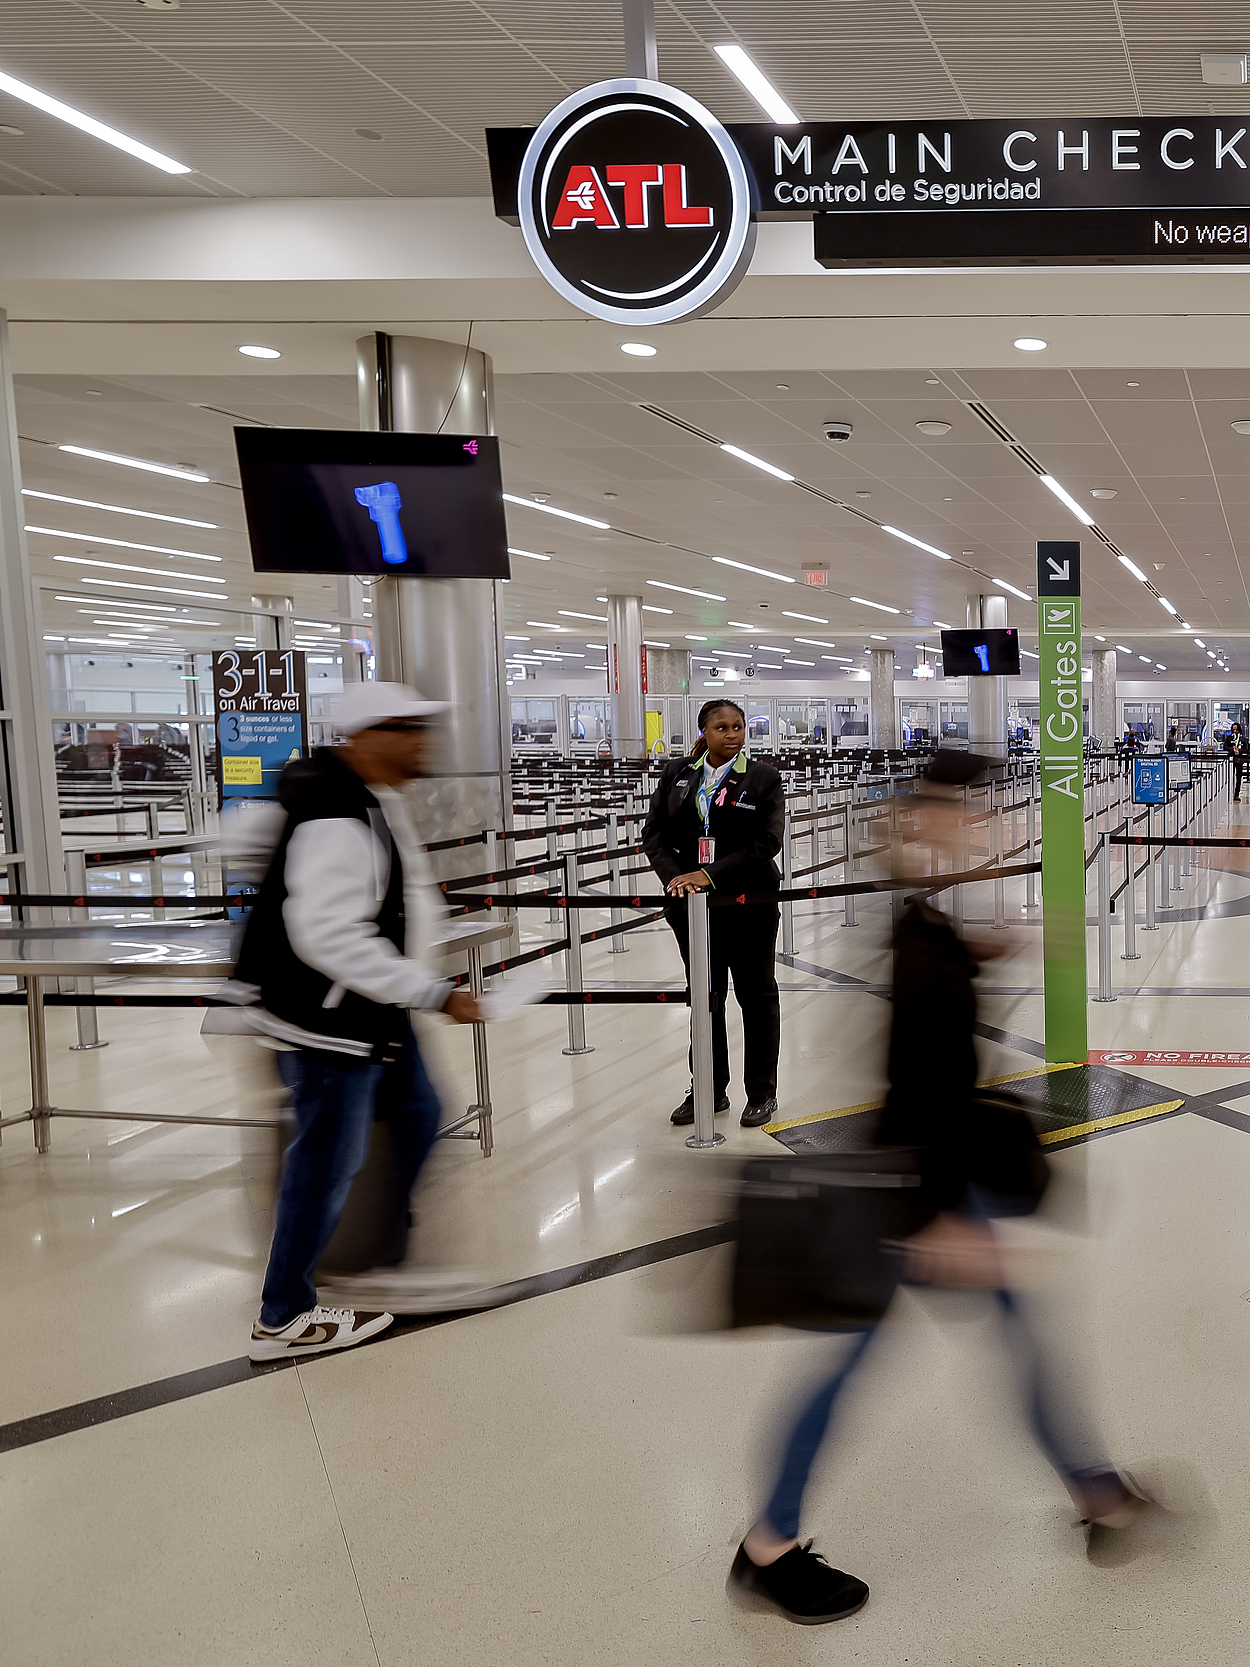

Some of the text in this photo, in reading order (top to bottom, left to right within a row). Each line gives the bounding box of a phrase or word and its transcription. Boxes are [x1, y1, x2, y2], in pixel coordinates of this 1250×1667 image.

[773, 132, 952, 176] MAIN
[551, 164, 714, 230] ATL
[774, 176, 1042, 205] Control de Seguridad
[1154, 219, 1189, 245] No
[217, 650, 300, 698] 3-1-1
[219, 696, 300, 711] on Air Travel
[227, 717, 240, 742] 3
[240, 715, 245, 723] 3
[279, 715, 293, 723] less
[254, 725, 288, 733] containers
[288, 725, 296, 733] of
[1044, 640, 1080, 800] All Gates
[240, 735, 258, 743] liquid
